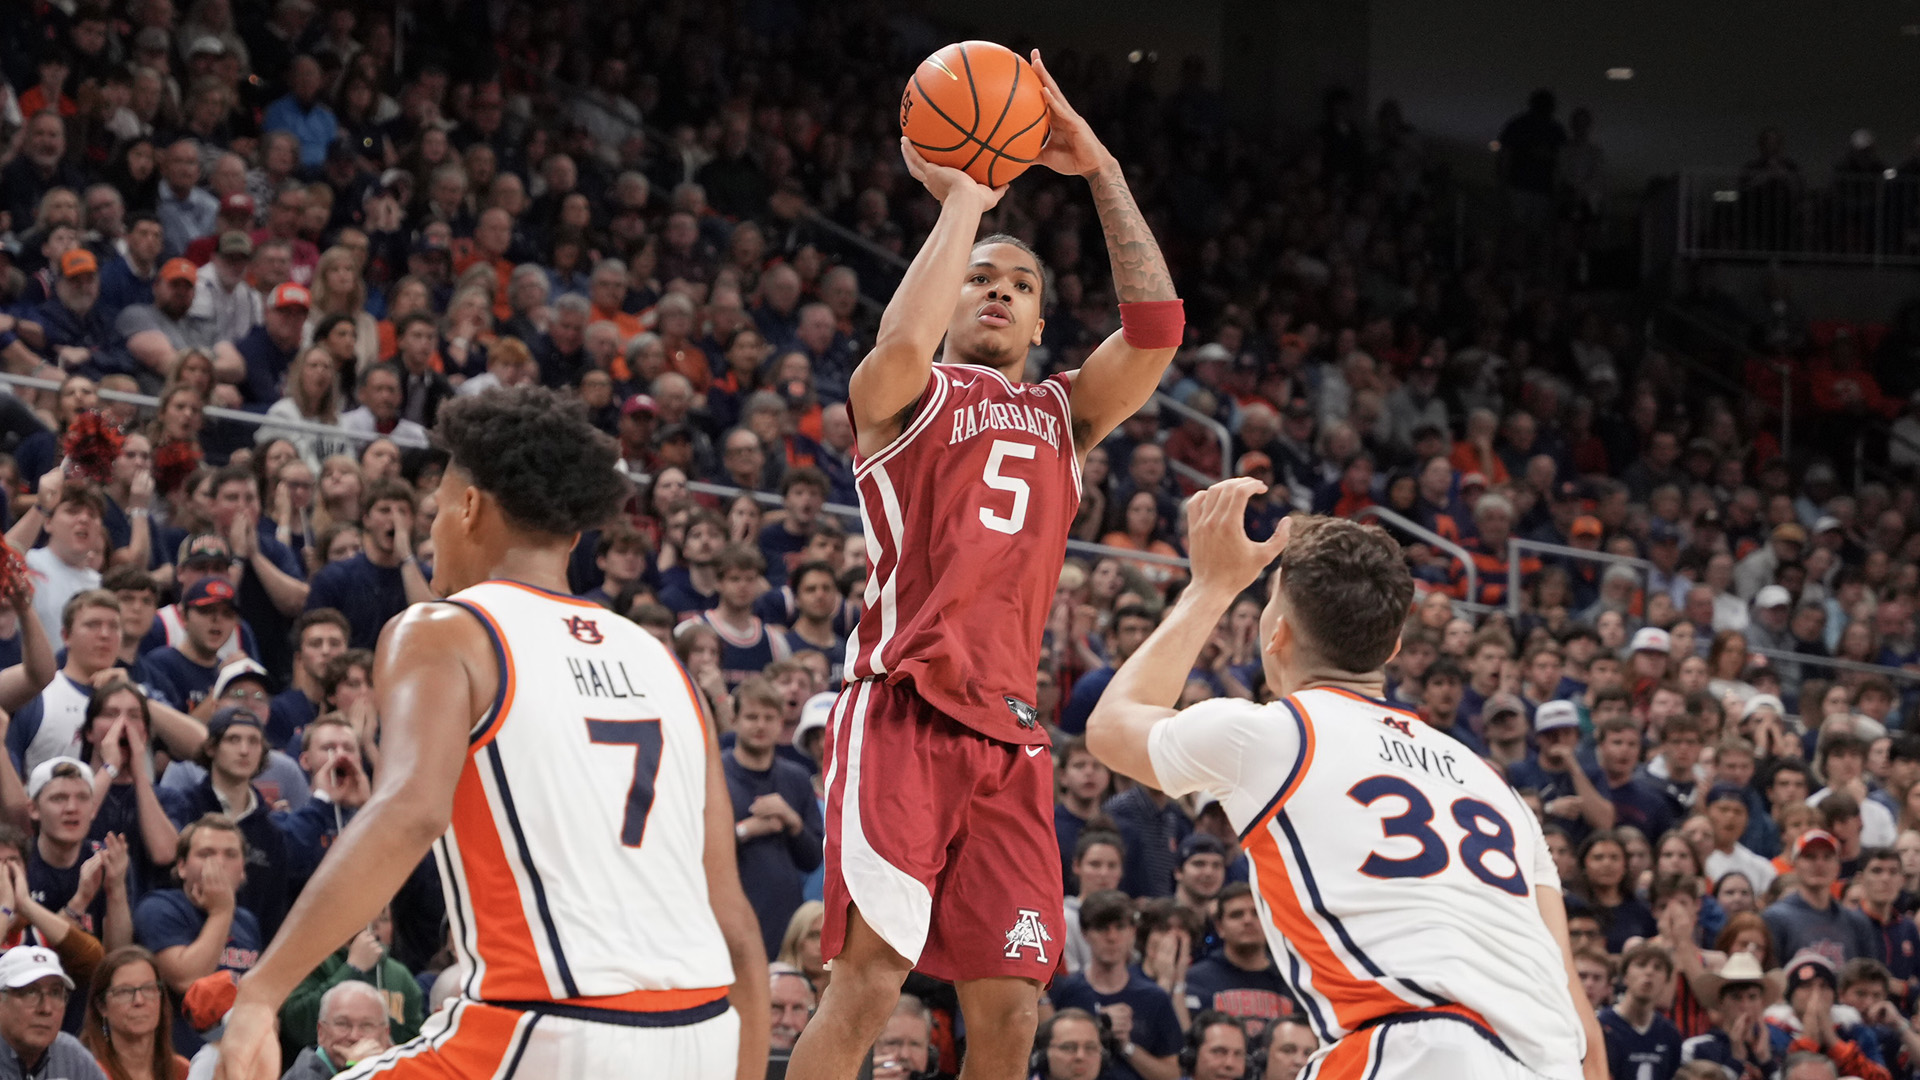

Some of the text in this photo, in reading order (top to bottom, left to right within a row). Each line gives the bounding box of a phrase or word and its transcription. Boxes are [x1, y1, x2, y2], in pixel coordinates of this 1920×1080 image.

[949, 398, 1061, 457] RAZORBACK
[979, 439, 1036, 535] 5
[567, 656, 646, 698] HALL
[584, 717, 664, 848] 7
[1346, 774, 1530, 898] 38
